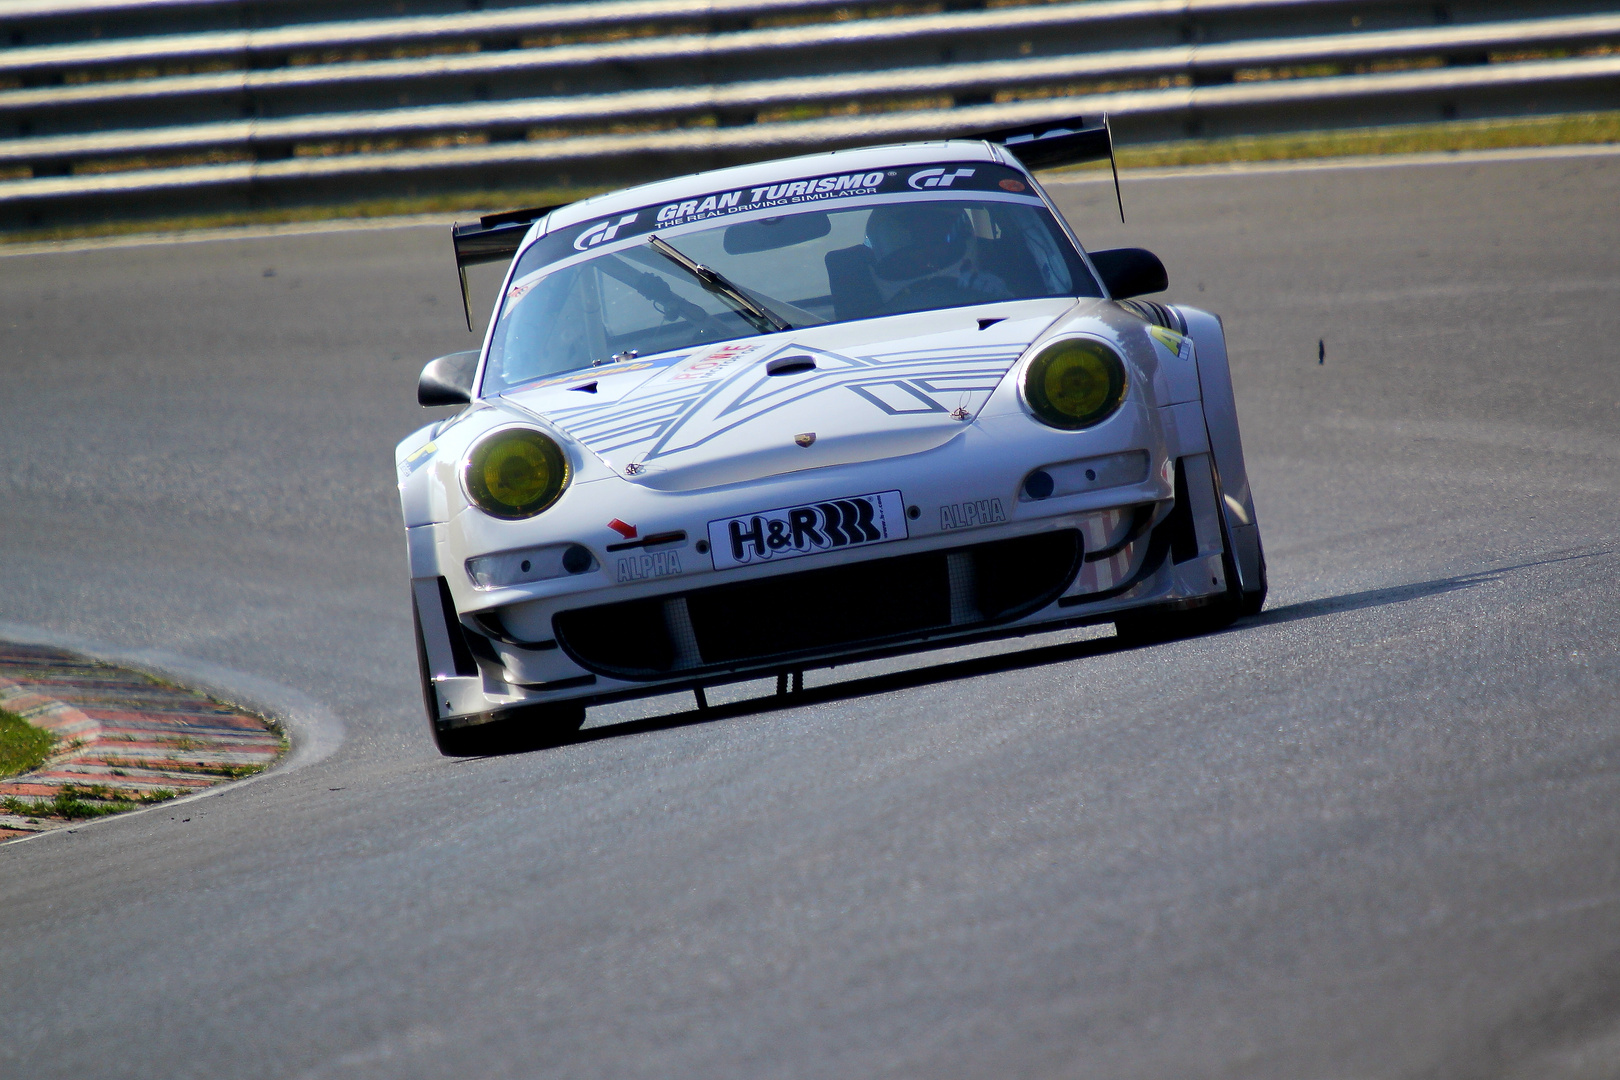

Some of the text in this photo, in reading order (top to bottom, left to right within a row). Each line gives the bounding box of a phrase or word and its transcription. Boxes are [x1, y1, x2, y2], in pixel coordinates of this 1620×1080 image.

[655, 187, 877, 229] THE REAL DRIVING SIMULATOR
[656, 171, 885, 222] GRAN TURISMO
[671, 344, 753, 381] ROWE
[940, 497, 1006, 530] ALPHA
[617, 550, 682, 582] ALPHA
